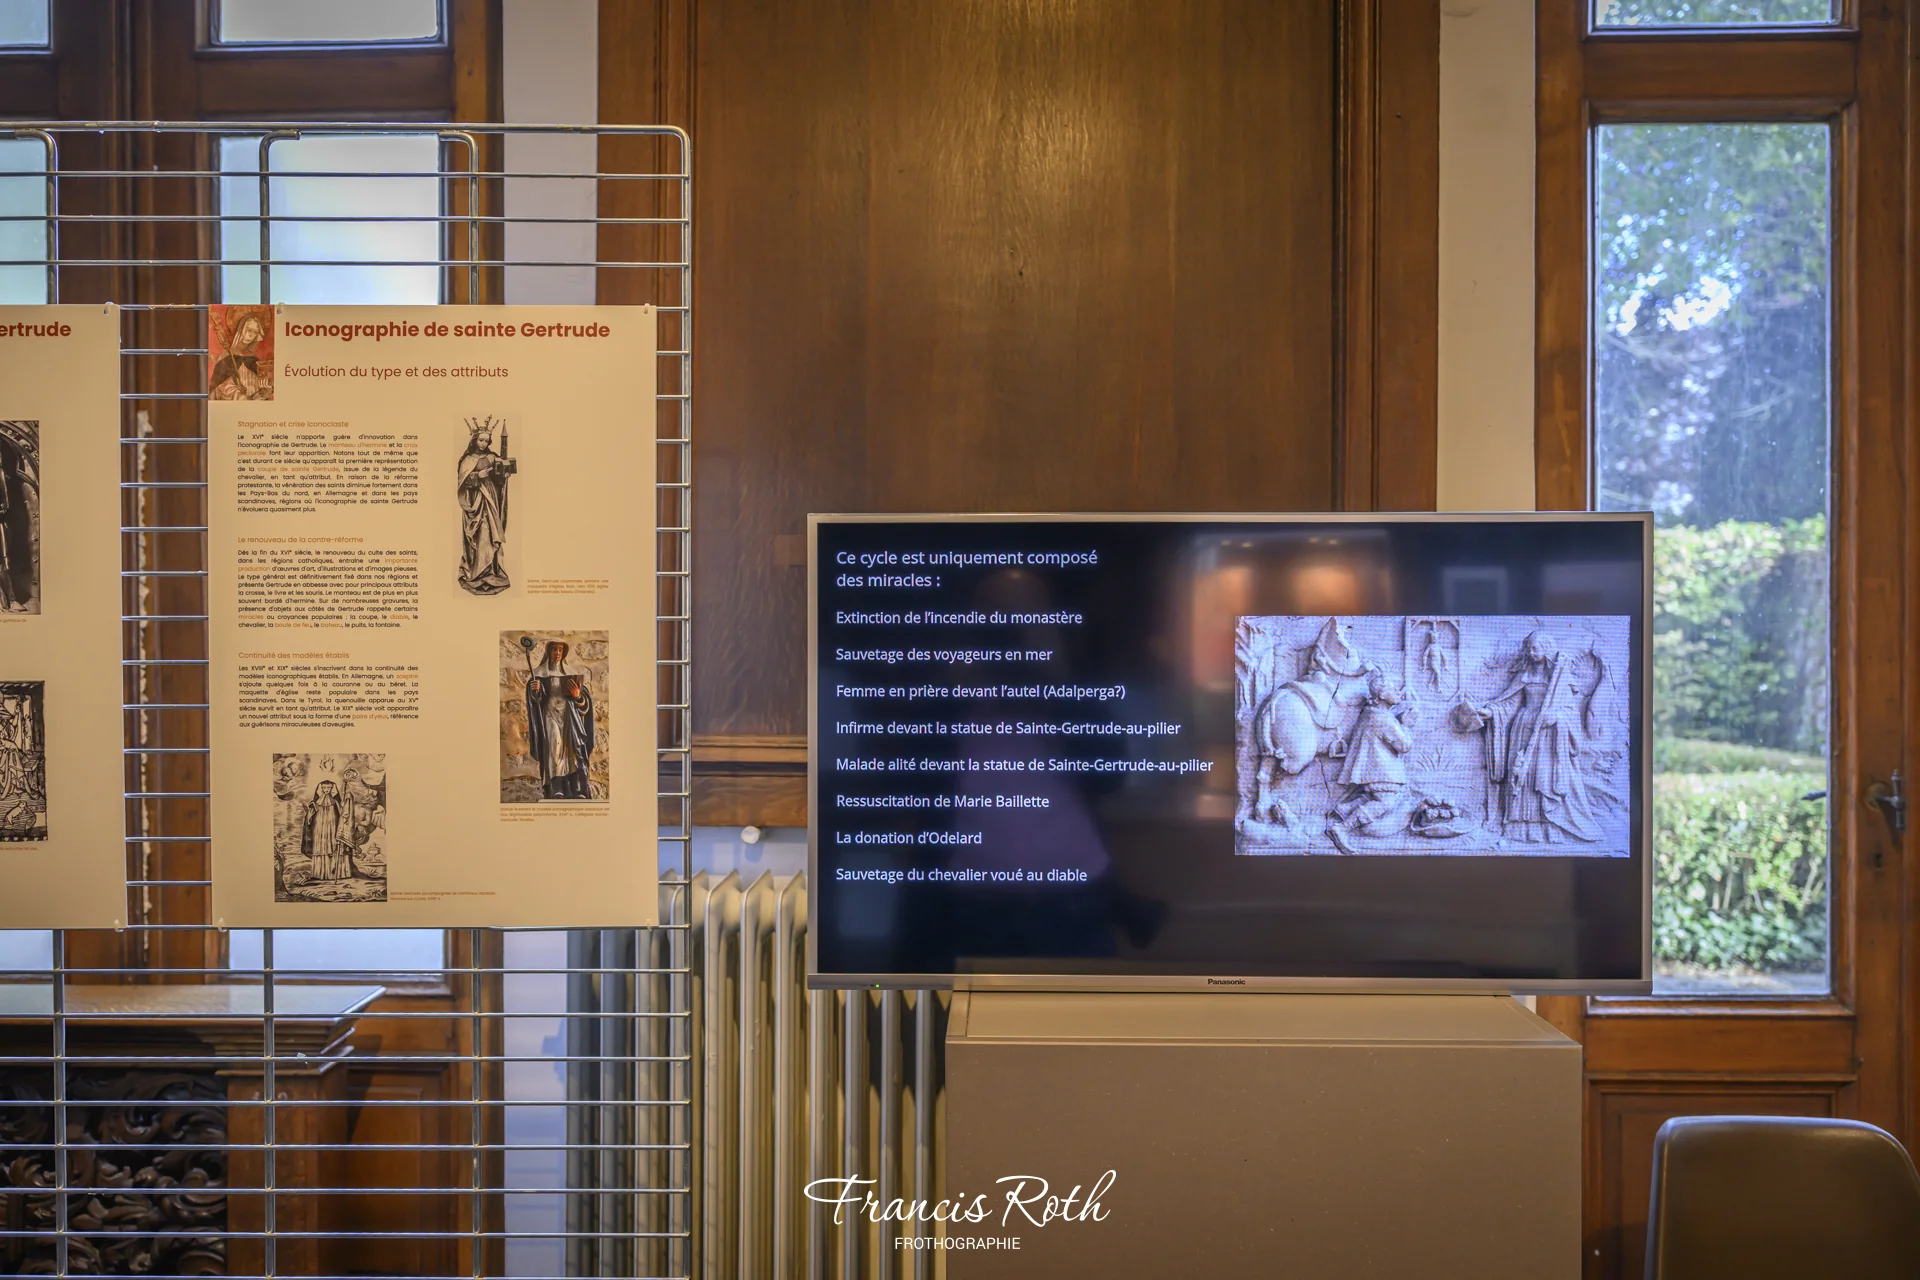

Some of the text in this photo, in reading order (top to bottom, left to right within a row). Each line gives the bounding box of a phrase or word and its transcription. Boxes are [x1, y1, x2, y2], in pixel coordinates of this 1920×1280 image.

[0, 322, 71, 337] ertrude
[286, 320, 610, 342] Iconographie de sainte Gertrude
[285, 364, 508, 380] Évolution du type et des attributs
[238, 421, 277, 429] Stagnation
[837, 550, 1097, 568] Ce cycle est uniquement composé
[837, 574, 940, 586] des miracles :
[837, 611, 1082, 624] Extinction de l'incendie du monastère
[836, 648, 1052, 664] Sauvetage des voyageurs en mer
[837, 684, 1125, 700] Femme en prière devant l'autel (Adalperga?)
[837, 722, 1181, 738] Infirme devant la statue de Sainte-Gertrude-au-pilier
[837, 758, 1214, 774] Malade alité devant la statue de Sainte-Gertrude-au-pilier
[837, 795, 1049, 807] Ressuscitation de Marie Baillette
[837, 831, 982, 844] La donation d'Odelard
[836, 868, 1087, 884] Sauvetage du chevalier voué au diable
